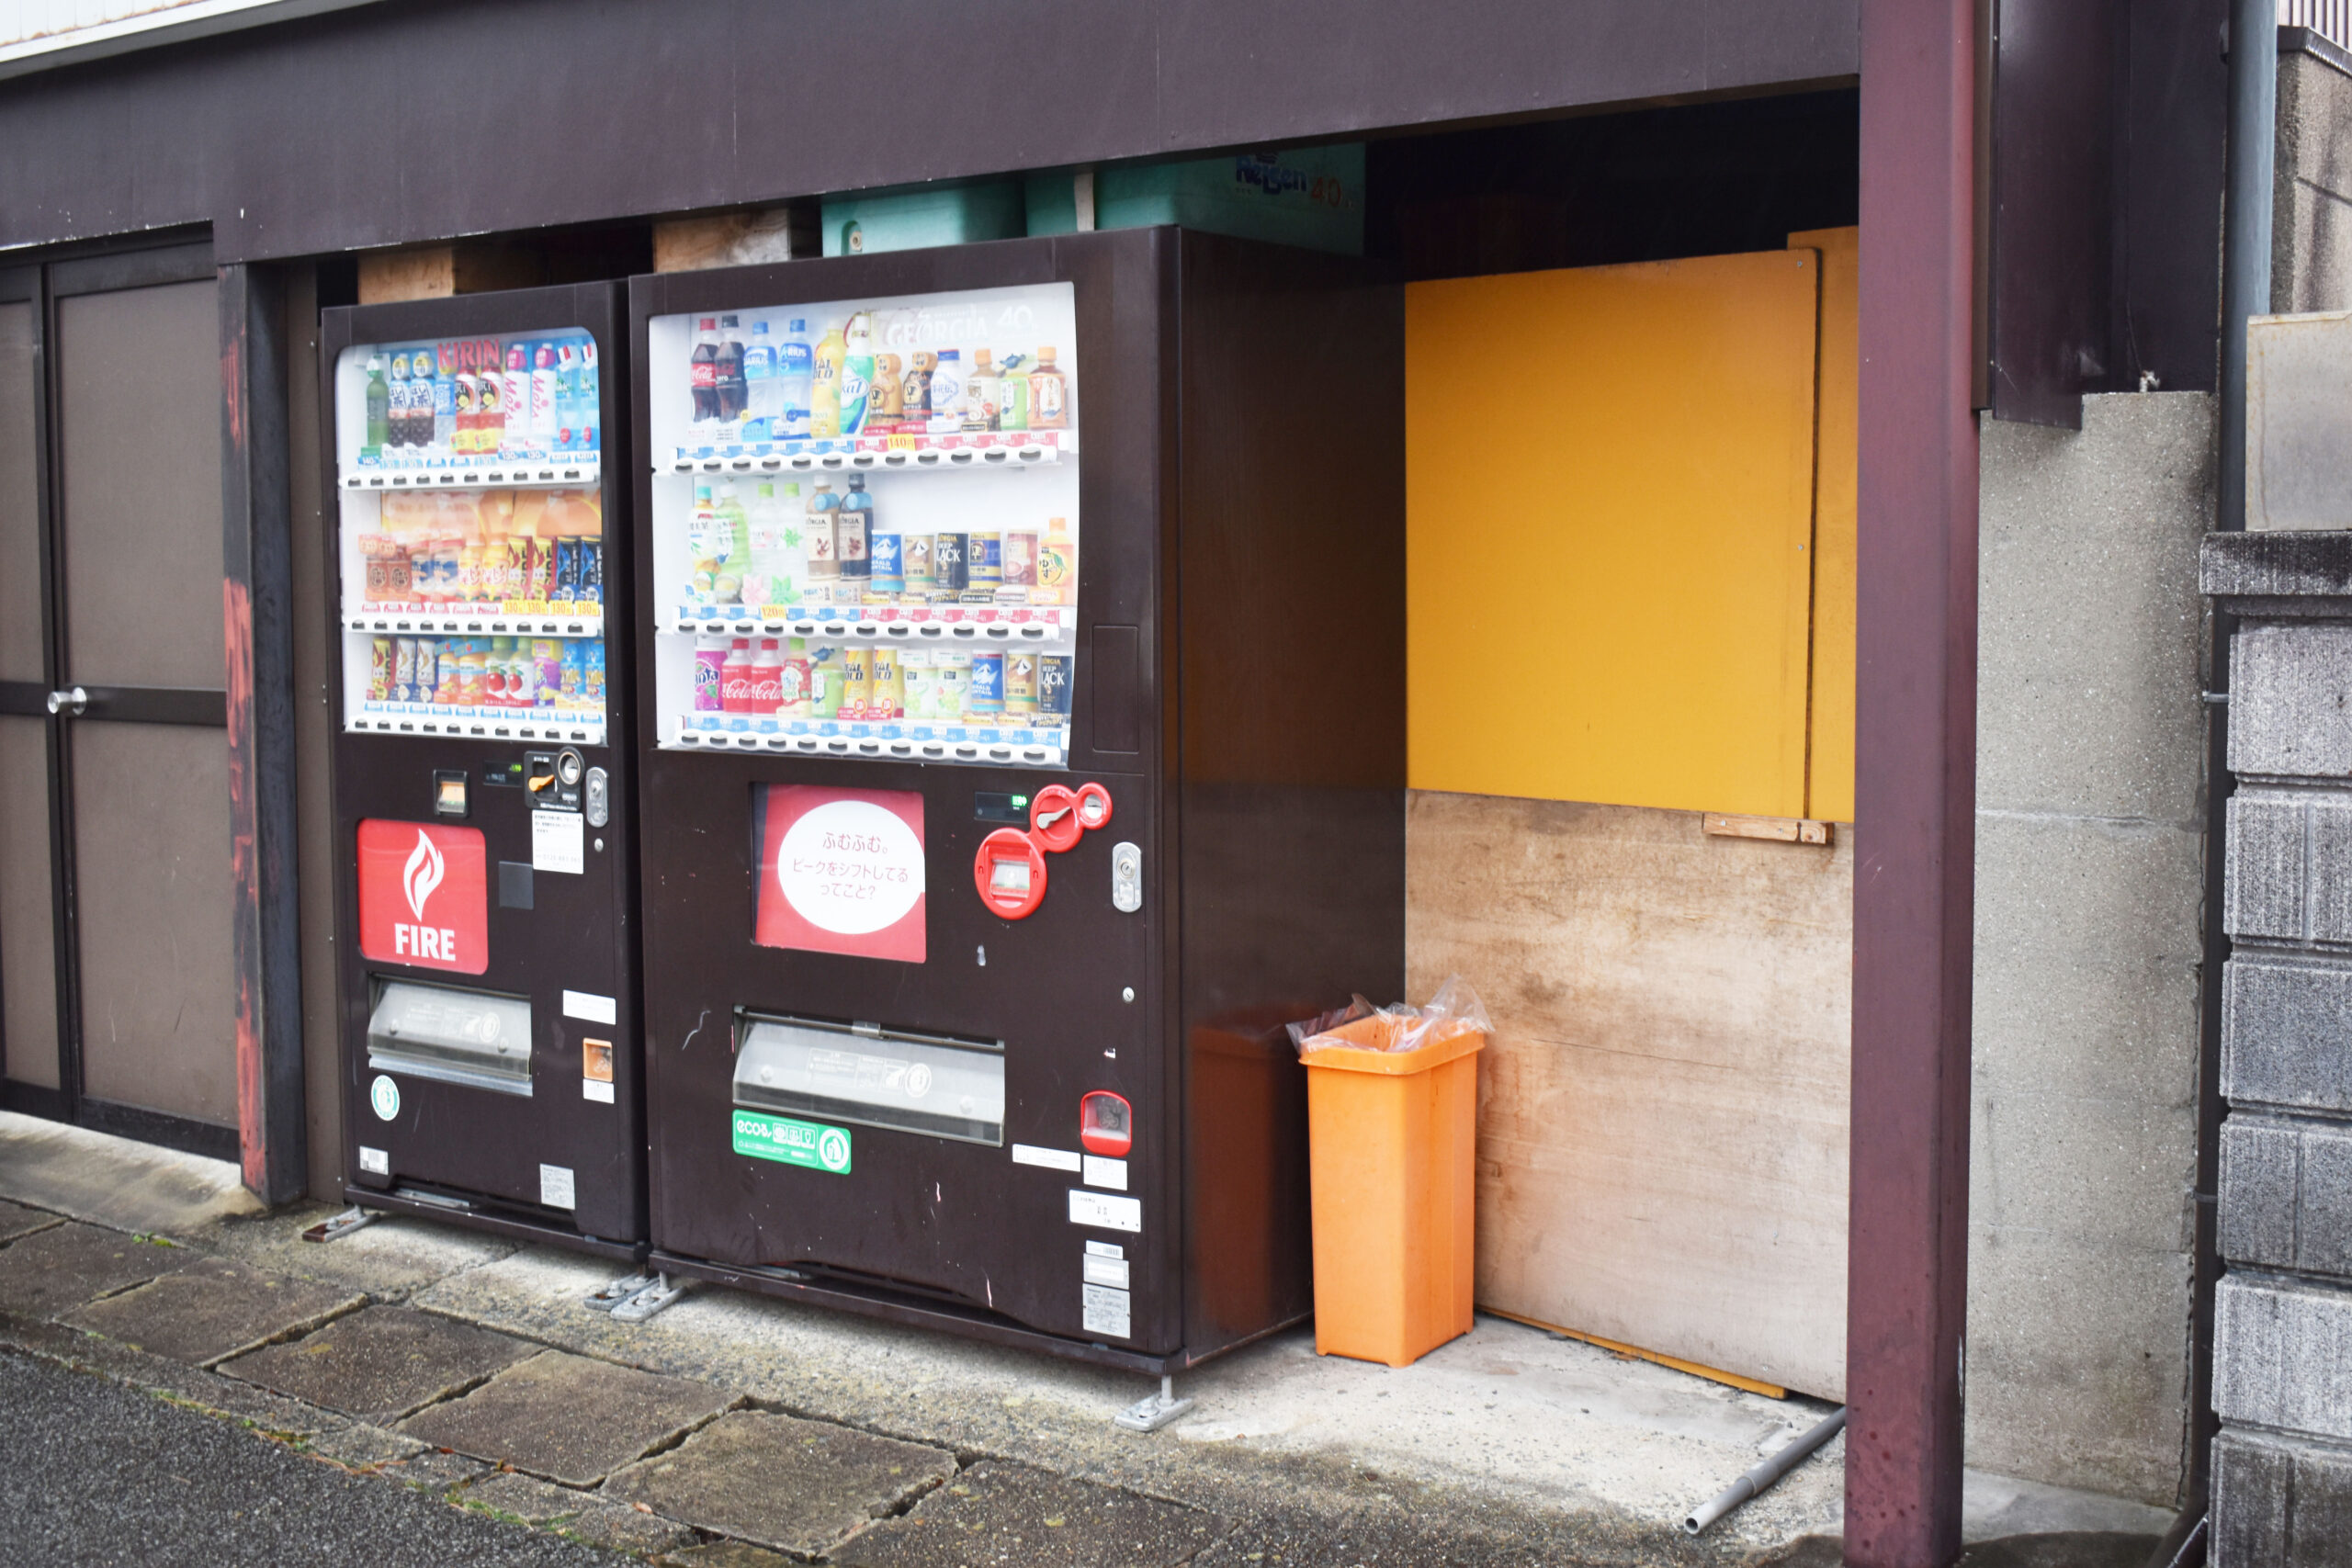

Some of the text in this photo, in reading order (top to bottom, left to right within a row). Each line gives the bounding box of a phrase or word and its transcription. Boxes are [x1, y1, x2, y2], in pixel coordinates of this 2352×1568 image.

[437, 339, 500, 368] KIRIN
[822, 832, 888, 854] ふむふむ。
[793, 858, 909, 883] ピークをシフトしてる
[820, 883, 876, 900] ってこと?
[394, 922, 457, 962] FIRE
